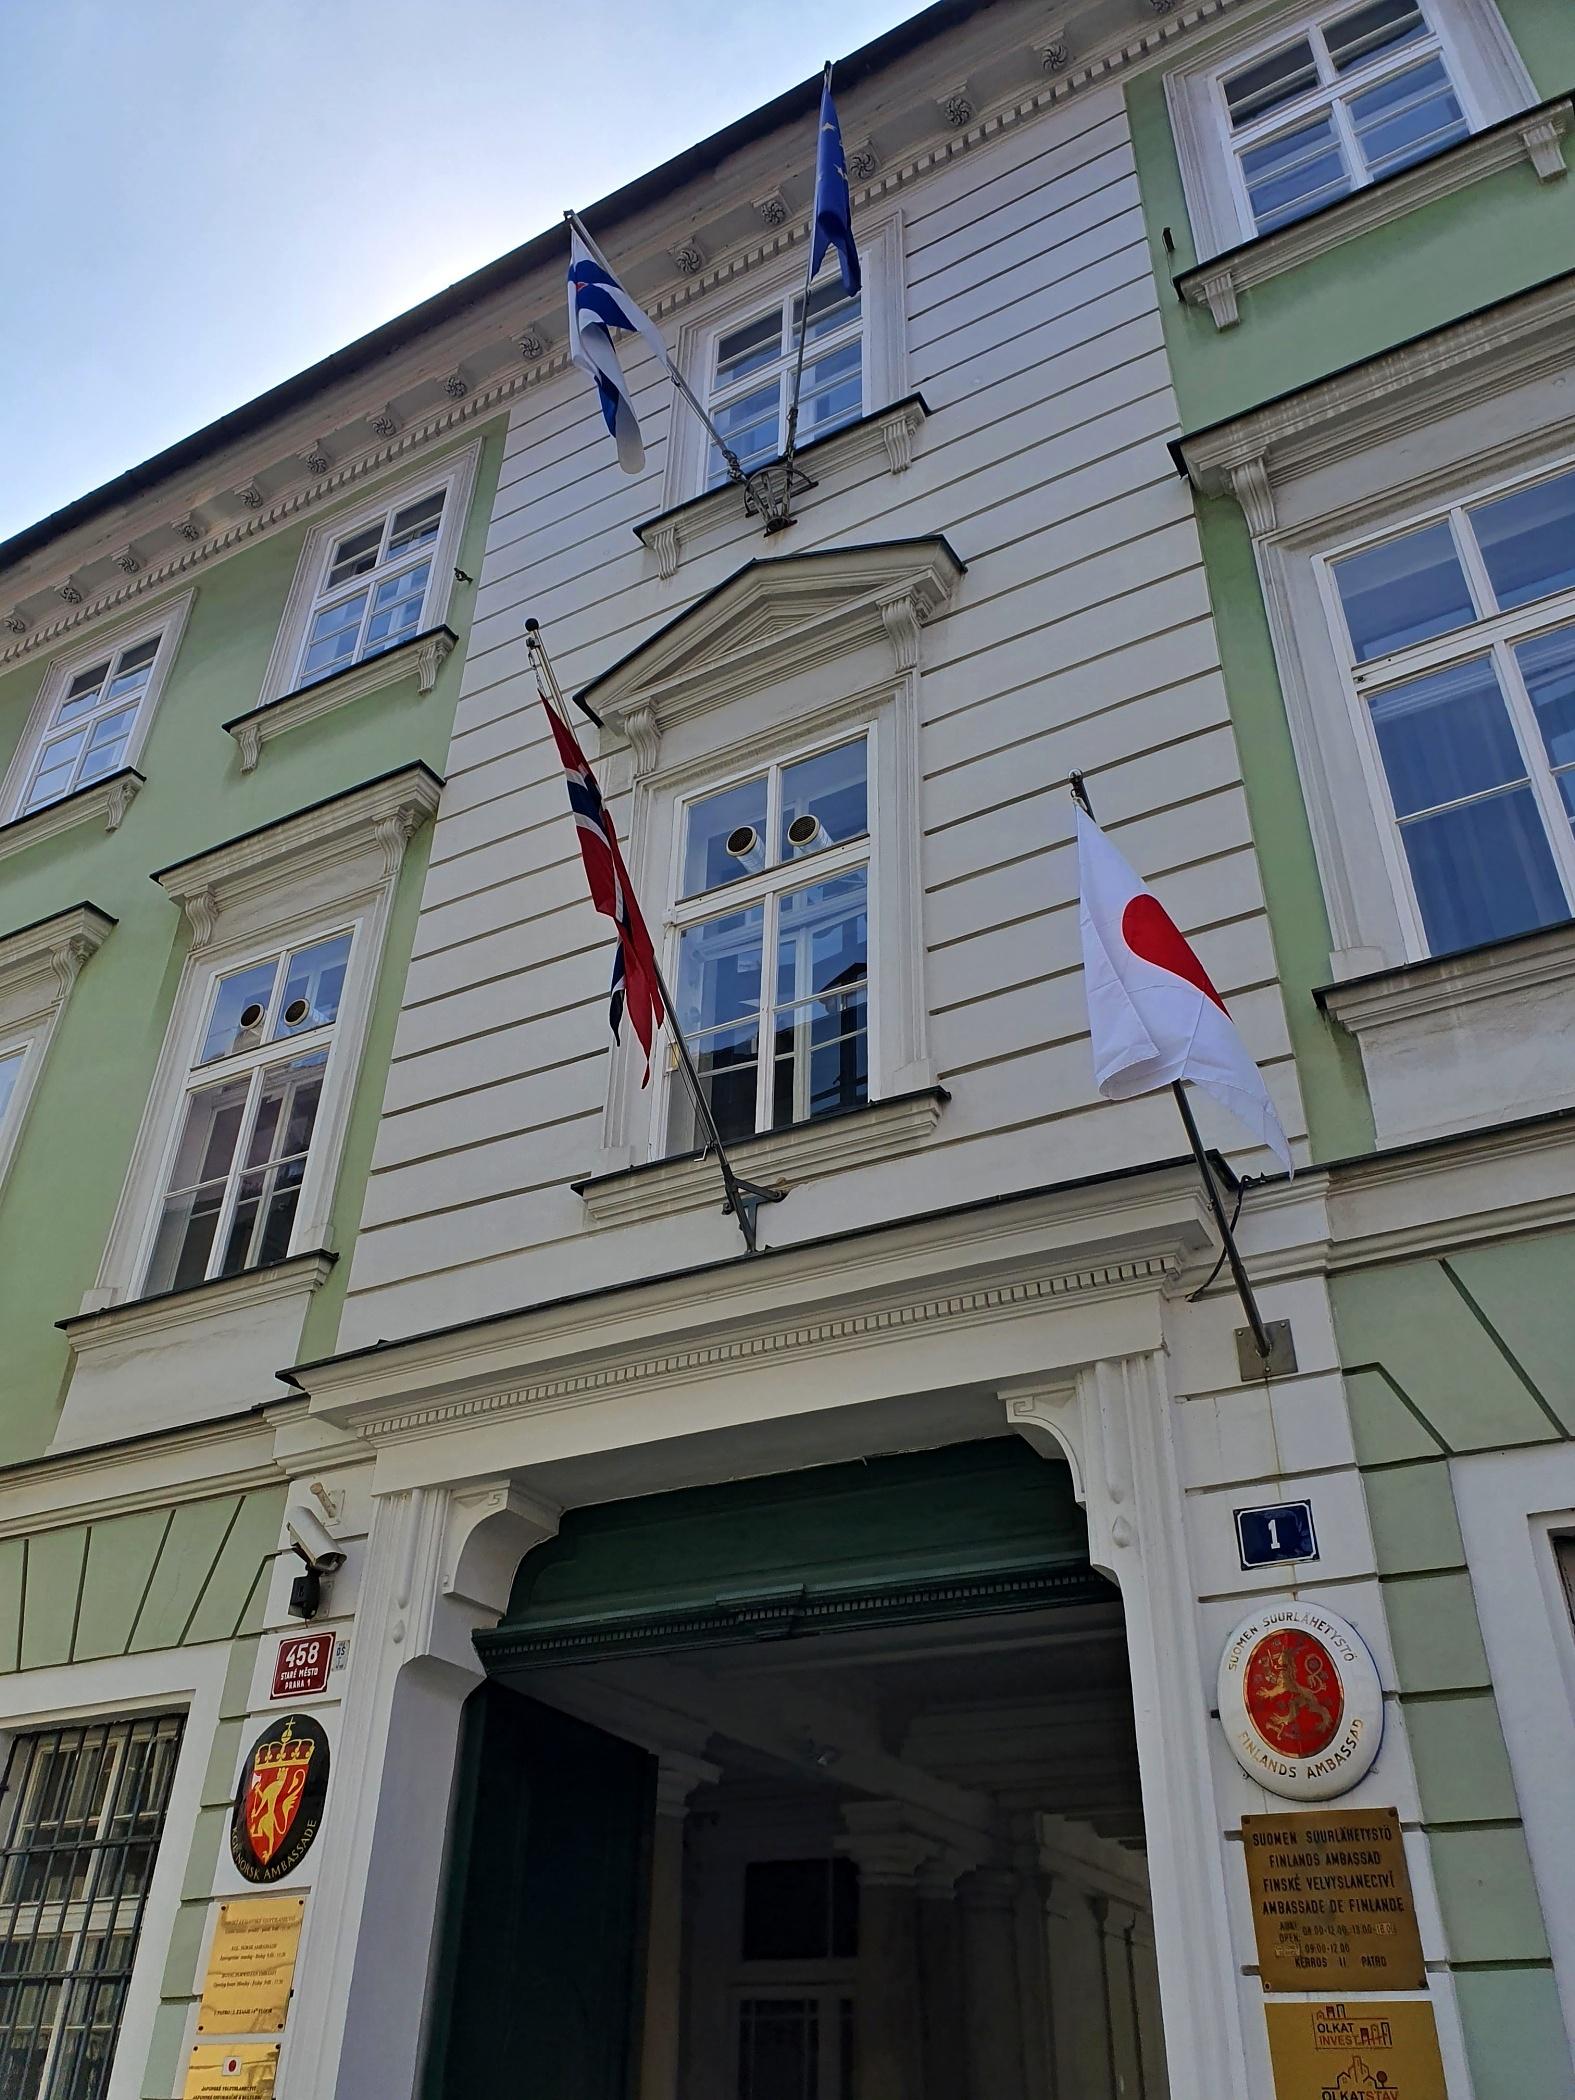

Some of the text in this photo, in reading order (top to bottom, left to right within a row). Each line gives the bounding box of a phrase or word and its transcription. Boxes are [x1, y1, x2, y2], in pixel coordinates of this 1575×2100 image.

[1267, 1518, 1281, 1550] 1
[1228, 1611, 1358, 1672] SUOMEN SUURLÄHETYSTÖ
[285, 1641, 320, 1668] 458
[280, 1667, 319, 1681] STARÉ MĚSTO
[284, 1678, 311, 1690] PRAHA 1
[1238, 1719, 1364, 1779] FINLANDS AMBASSAD
[1252, 1824, 1393, 1847] SUOMEN SUURLÄHETYSTÖ
[236, 1852, 260, 1880] NORSK
[263, 1818, 317, 1880] AMBASSADE
[1269, 1850, 1382, 1868] FINLANDS AMBASSAD
[1262, 1870, 1396, 1893] FINSKÉ VELVYSLANECTVÍ
[1262, 1897, 1406, 1916] AMBASSADE DE FINLANDE
[1295, 1956, 1328, 1969] KERROS
[1360, 1955, 1388, 1968] PATRO
[1316, 2022, 1355, 2034] OLKAT
[1319, 2035, 1360, 2046] INVEST
